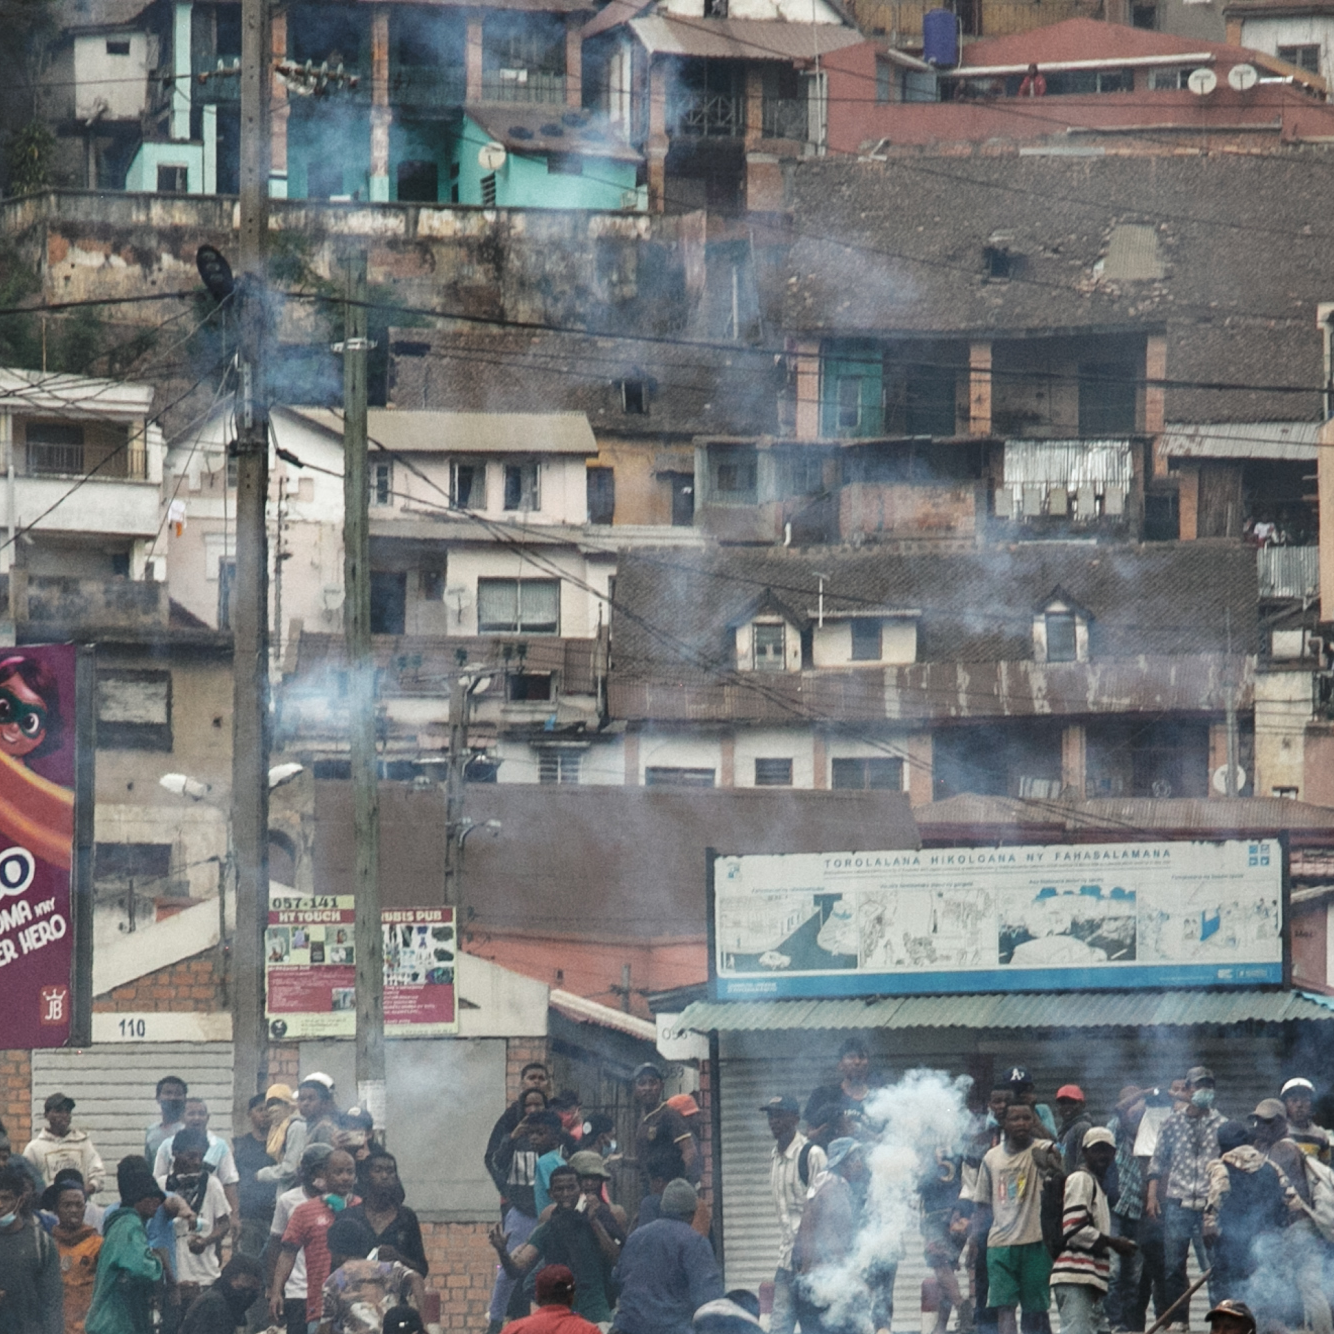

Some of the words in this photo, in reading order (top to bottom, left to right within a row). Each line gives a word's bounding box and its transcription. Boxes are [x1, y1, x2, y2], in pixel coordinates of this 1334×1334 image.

[825, 857, 920, 868] TOROLALANA
[1026, 853, 1044, 862] NY
[1055, 849, 1171, 862] FAHASALAMANA
[298, 910, 341, 922] TOUCH
[416, 910, 443, 922] PUB
[18, 914, 67, 955] HERO
[45, 1000, 63, 1020] JB
[119, 1018, 145, 1037] 110
